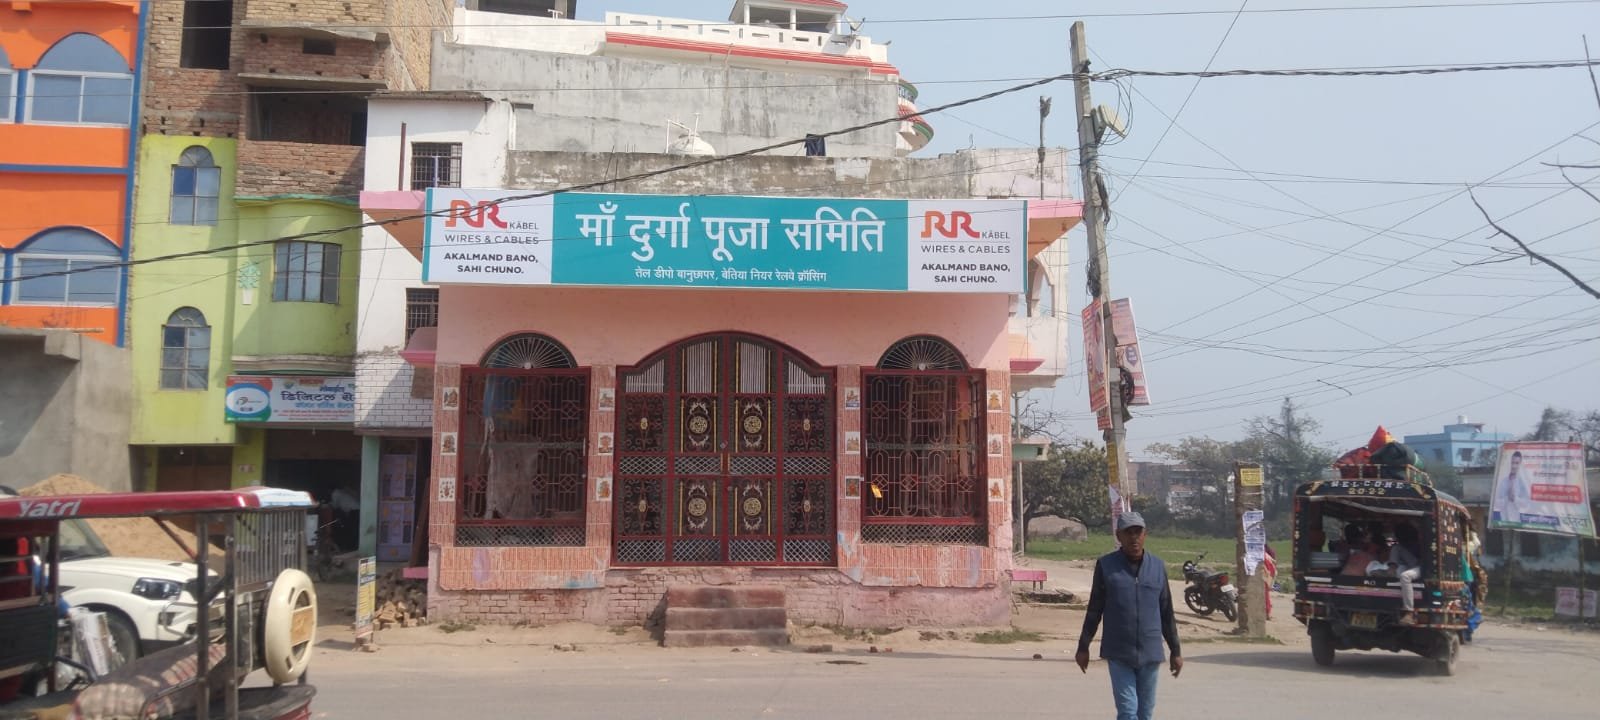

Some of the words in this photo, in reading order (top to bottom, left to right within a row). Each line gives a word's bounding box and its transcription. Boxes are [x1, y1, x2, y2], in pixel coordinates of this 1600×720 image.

[445, 199, 507, 229] RR
[920, 210, 980, 238] RR
[575, 200, 618, 247] माँ
[625, 202, 691, 262] दुर्गा
[701, 217, 770, 262] पूजा
[781, 206, 886, 252] समिति
[444, 234, 482, 243] WIRES
[484, 235, 492, 244] &
[494, 235, 540, 245] CABLES
[920, 245, 956, 253] WIRES
[958, 245, 965, 253] &
[968, 245, 1011, 254] CABLES
[444, 252, 503, 262] AKALMAND
[505, 254, 539, 264] BANO,
[457, 264, 482, 273] SAHI
[484, 265, 524, 274] CHUNO.
[634, 266, 651, 279] तेल
[653, 265, 674, 279] डीपो
[774, 267, 795, 281] रेलवे
[921, 263, 977, 271] AKALMAND
[979, 263, 1011, 272] BANO,
[934, 275, 957, 283] SAHI
[959, 275, 998, 284] CHUNO.
